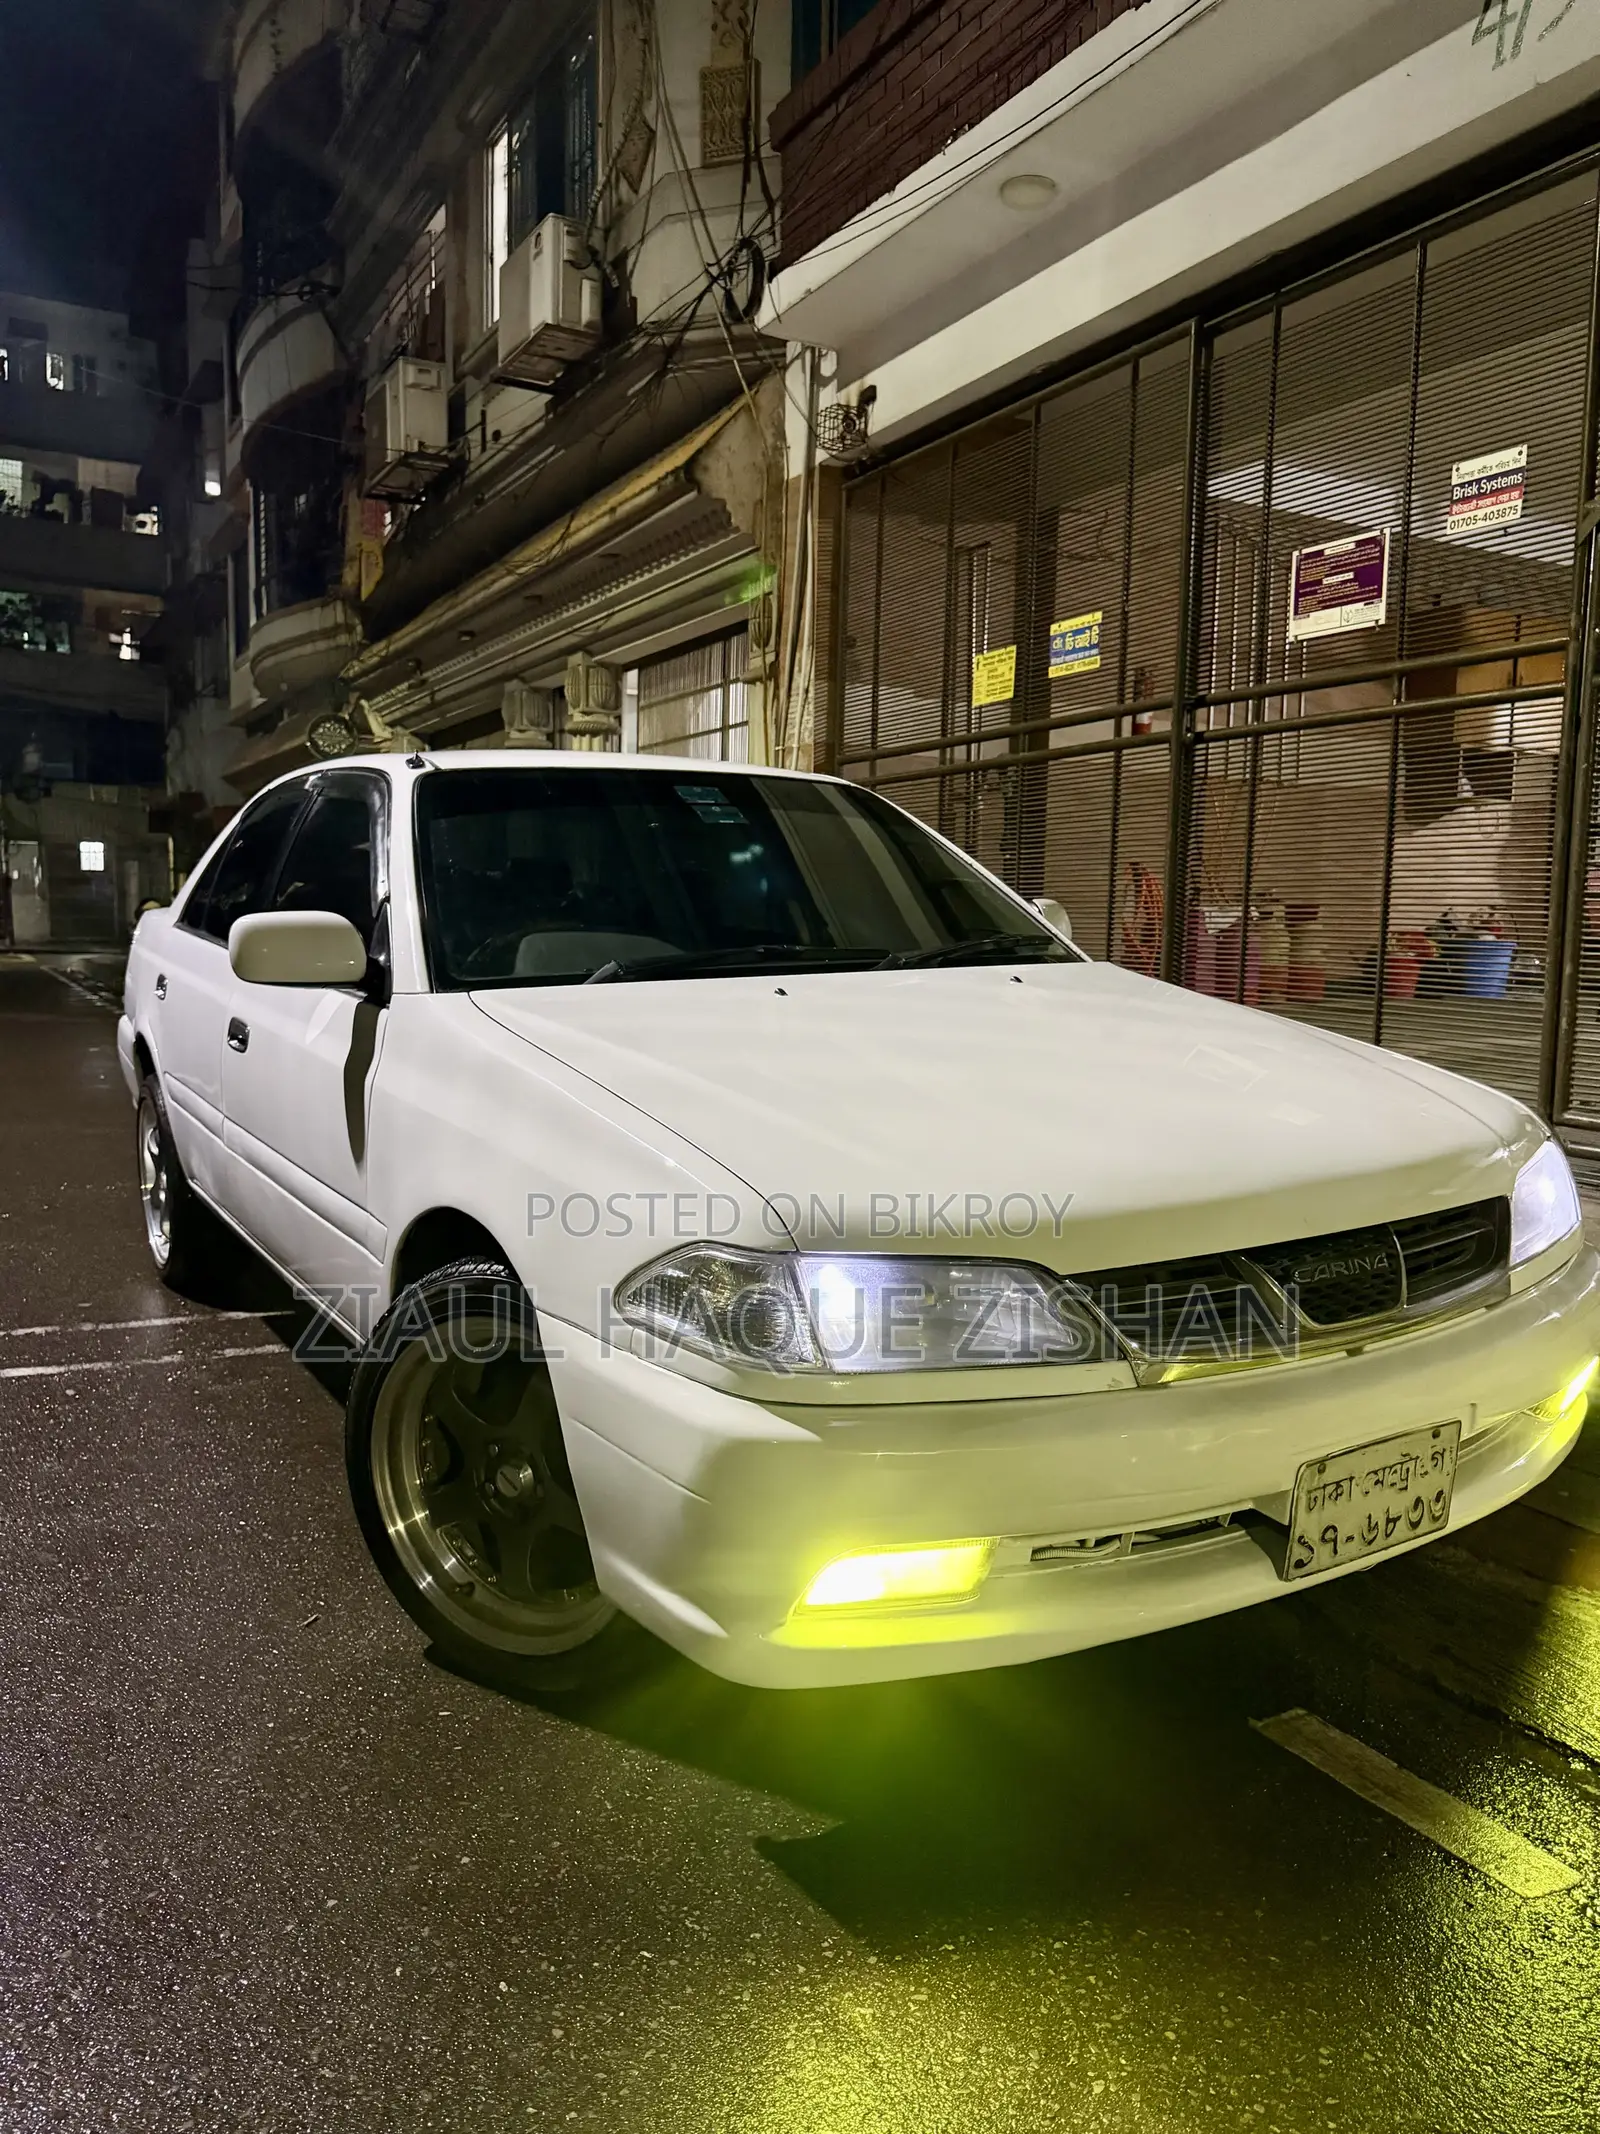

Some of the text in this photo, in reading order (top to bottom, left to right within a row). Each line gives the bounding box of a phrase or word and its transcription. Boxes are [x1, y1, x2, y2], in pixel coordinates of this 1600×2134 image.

[1453, 473, 1523, 500] Brisk Systems
[1450, 505, 1519, 530] 01705-403875
[1293, 1252, 1389, 1283] CARINA
[1306, 1475, 1355, 1512] ঢাকা
